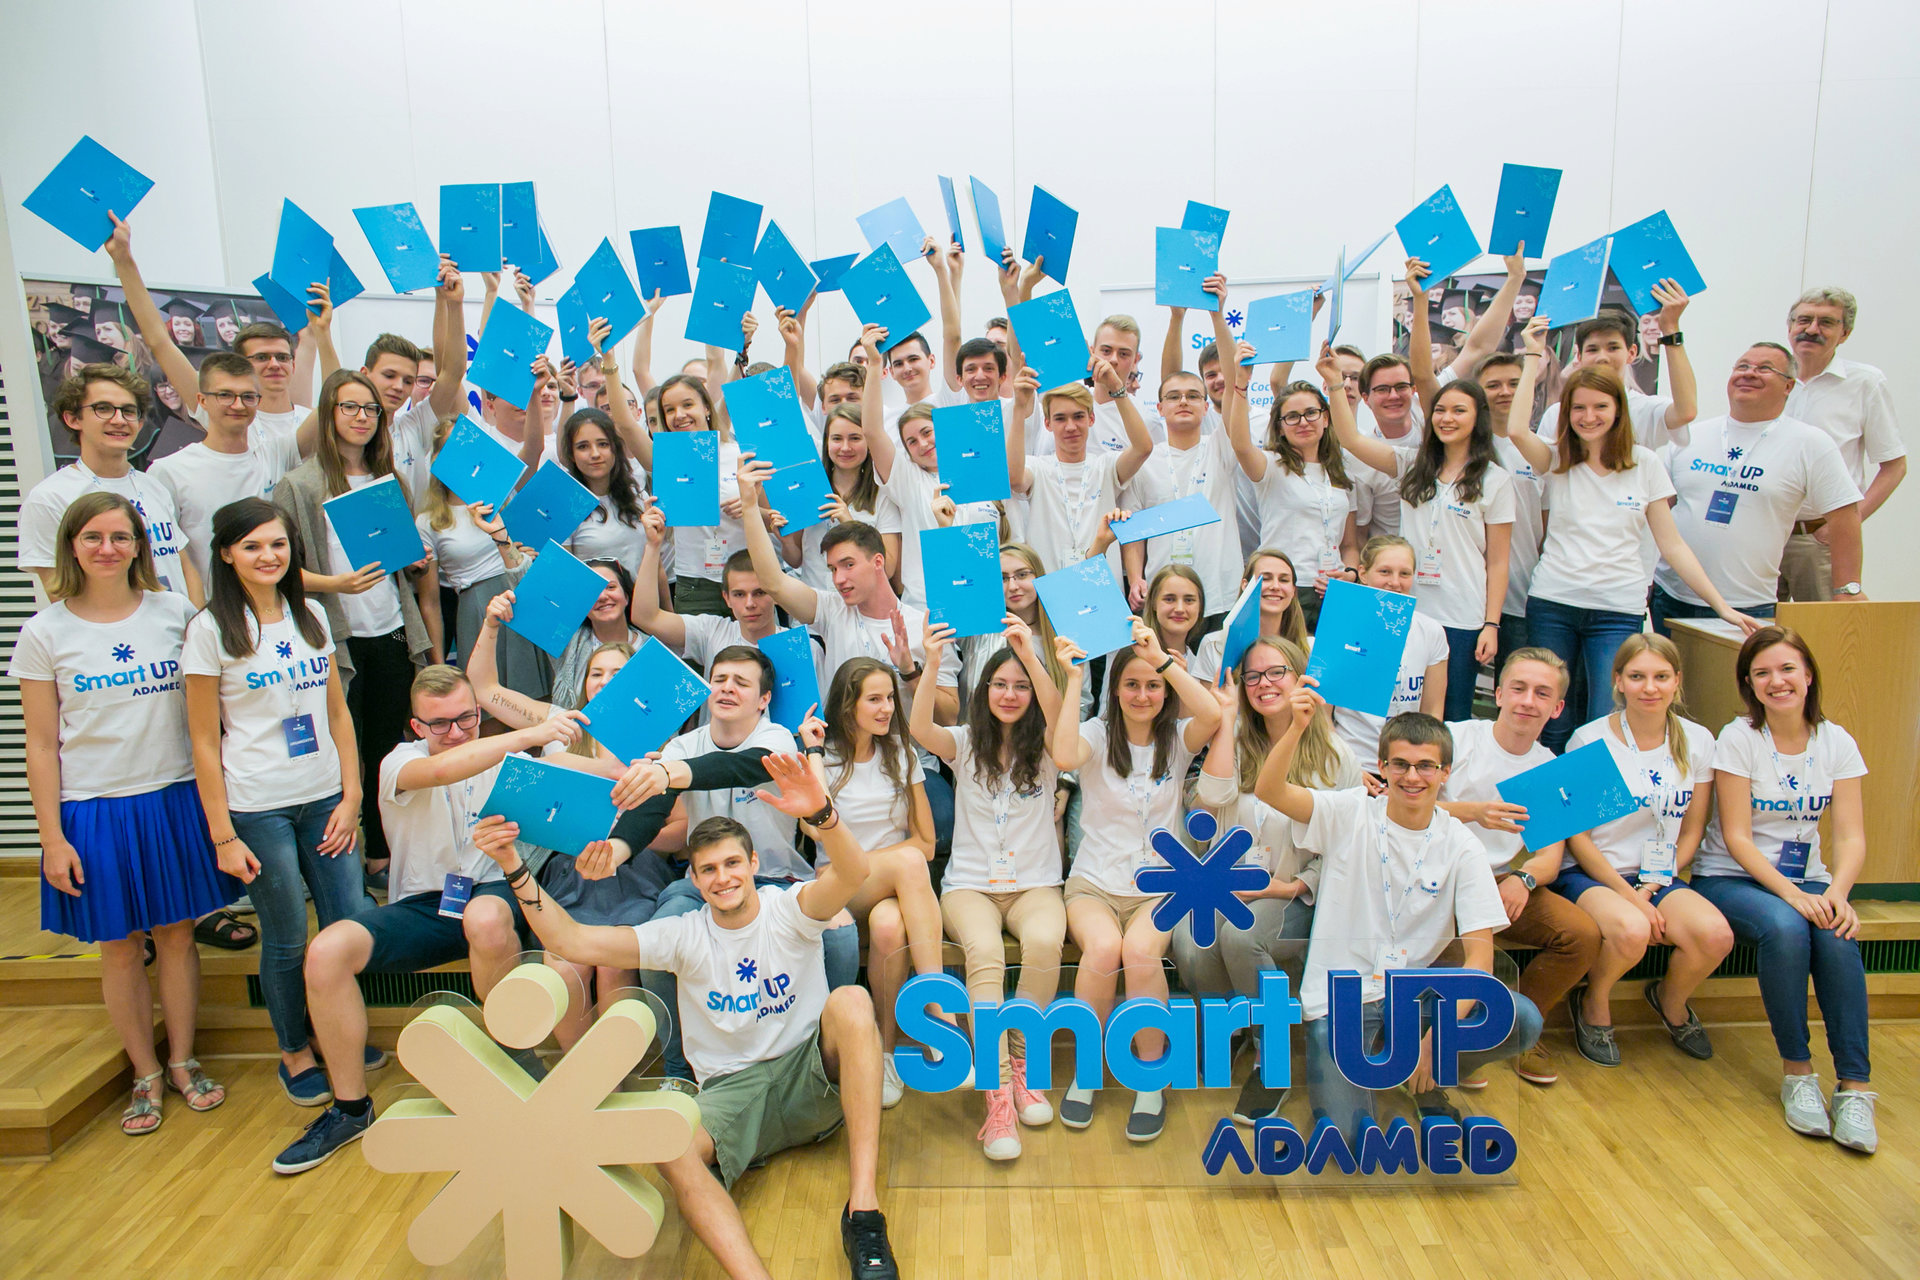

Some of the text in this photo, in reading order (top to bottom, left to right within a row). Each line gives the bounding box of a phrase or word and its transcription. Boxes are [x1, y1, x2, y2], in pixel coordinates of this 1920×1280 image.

[1690, 458, 1764, 480] Smar UP
[74, 660, 179, 692] Smart UP
[763, 973, 790, 999] UP
[894, 968, 1517, 1093] Smart UP
[1202, 1115, 1519, 1177] ADAMED
